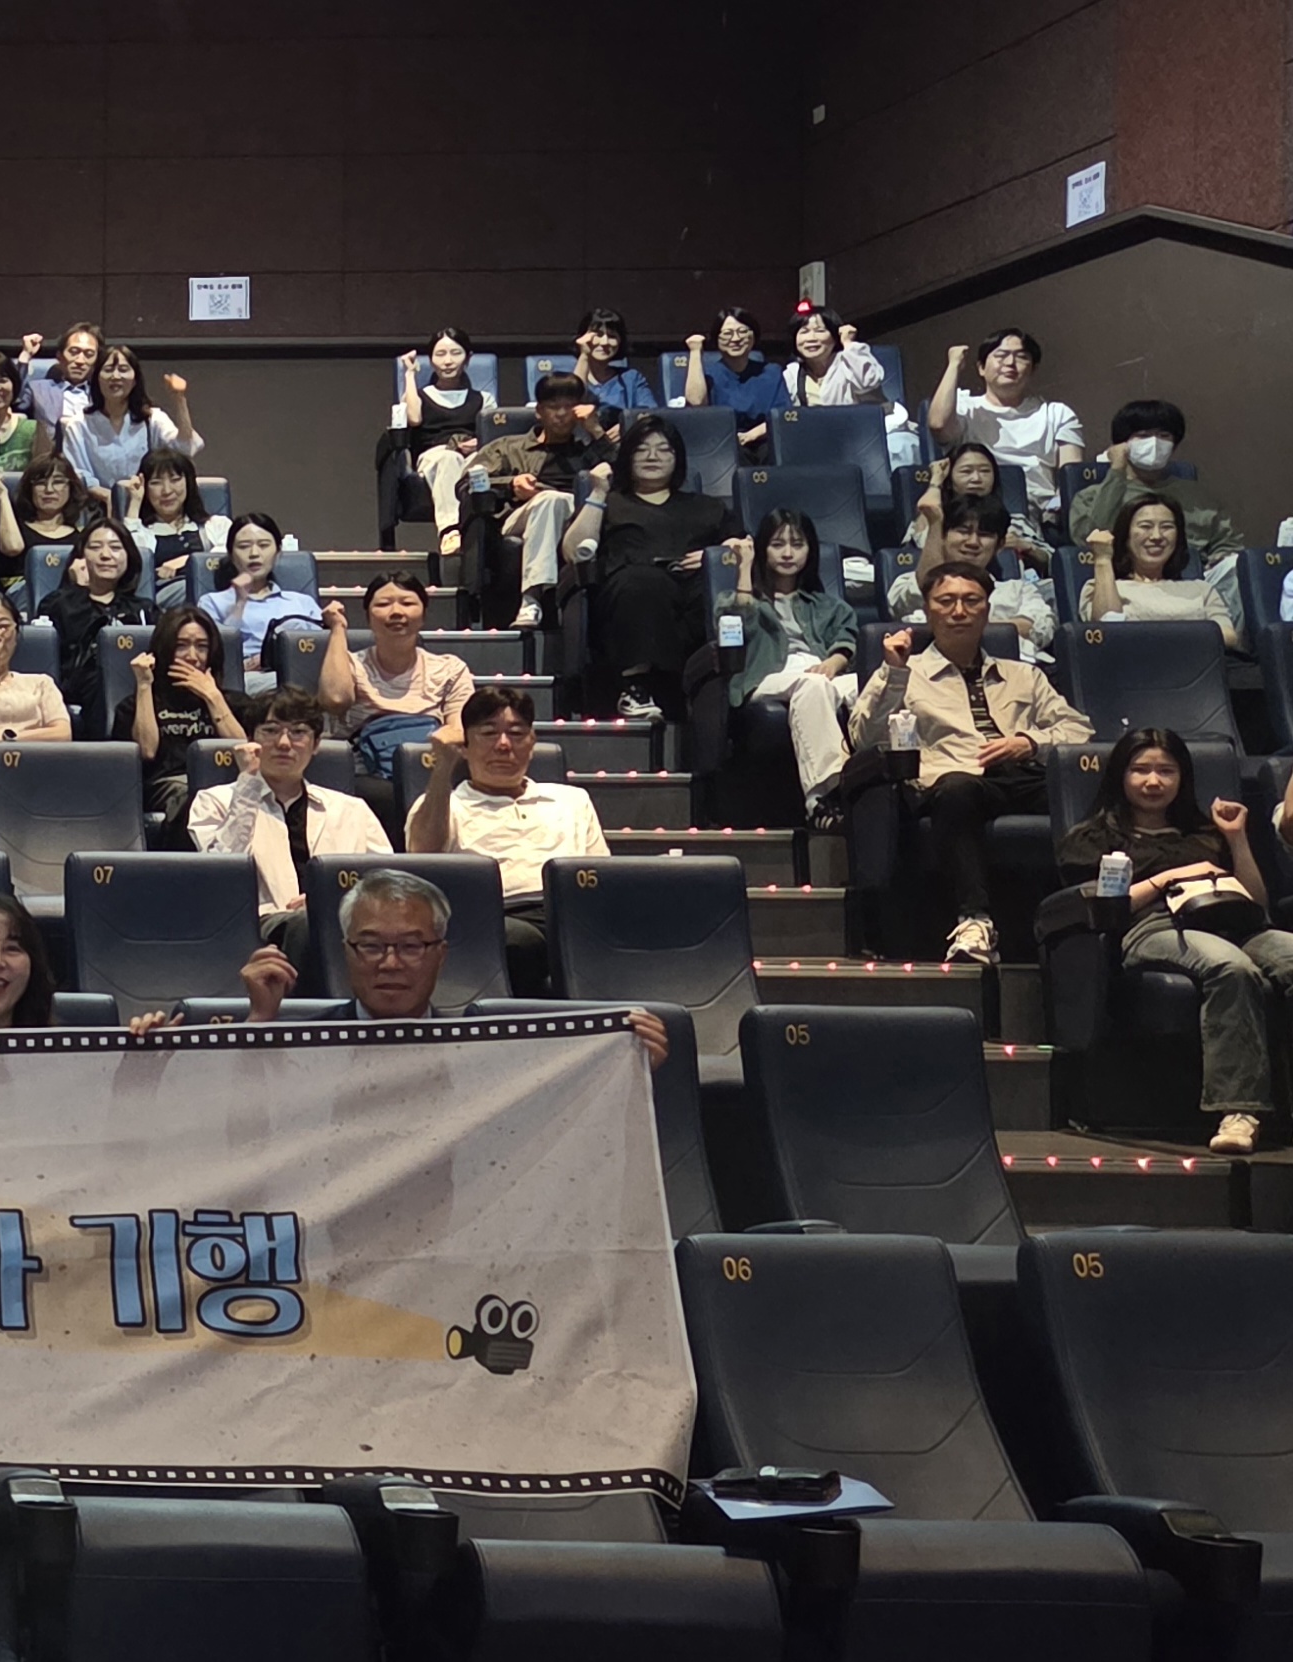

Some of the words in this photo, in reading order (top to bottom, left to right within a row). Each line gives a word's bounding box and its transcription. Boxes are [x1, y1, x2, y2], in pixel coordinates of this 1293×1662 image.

[784, 410, 798, 422] 02
[752, 470, 768, 483] 03
[915, 470, 929, 482] 02
[1083, 468, 1097, 480] 01
[45, 553, 60, 567] 06
[897, 553, 913, 565] 03
[1078, 551, 1094, 564] 02
[1265, 553, 1281, 565] 01
[117, 635, 133, 650] 06
[1085, 628, 1102, 644] 03
[298, 639, 315, 653] 05
[3, 751, 21, 767] 07
[215, 750, 232, 766] 06
[1080, 754, 1100, 772] 04
[93, 865, 114, 884] 07
[338, 870, 359, 888] 06
[577, 869, 598, 888] 05
[785, 1024, 810, 1045] 05
[69, 1208, 306, 1338] 기행
[722, 1257, 752, 1281] 06
[1072, 1252, 1103, 1279] 05
